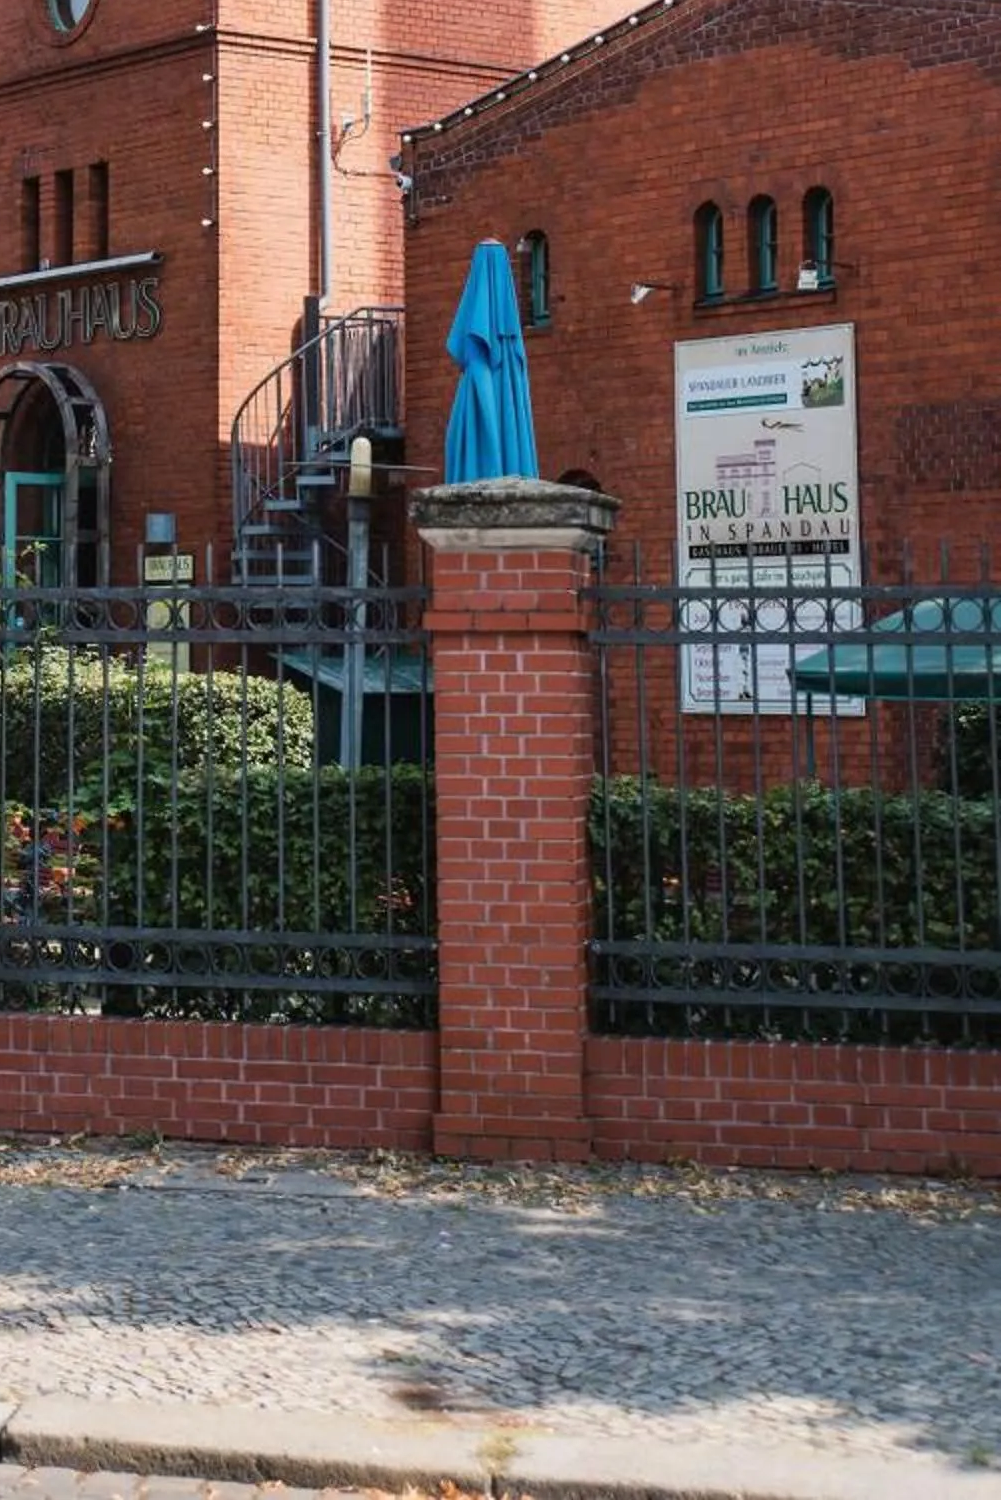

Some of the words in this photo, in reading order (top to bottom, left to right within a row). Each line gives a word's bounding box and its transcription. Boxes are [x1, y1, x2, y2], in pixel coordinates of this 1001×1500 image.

[685, 489, 746, 520] BRAU
[783, 482, 848, 514] HAUS
[687, 525, 710, 541] IN
[728, 518, 850, 541] SPANDAU
[692, 544, 742, 558] GASHAUS
